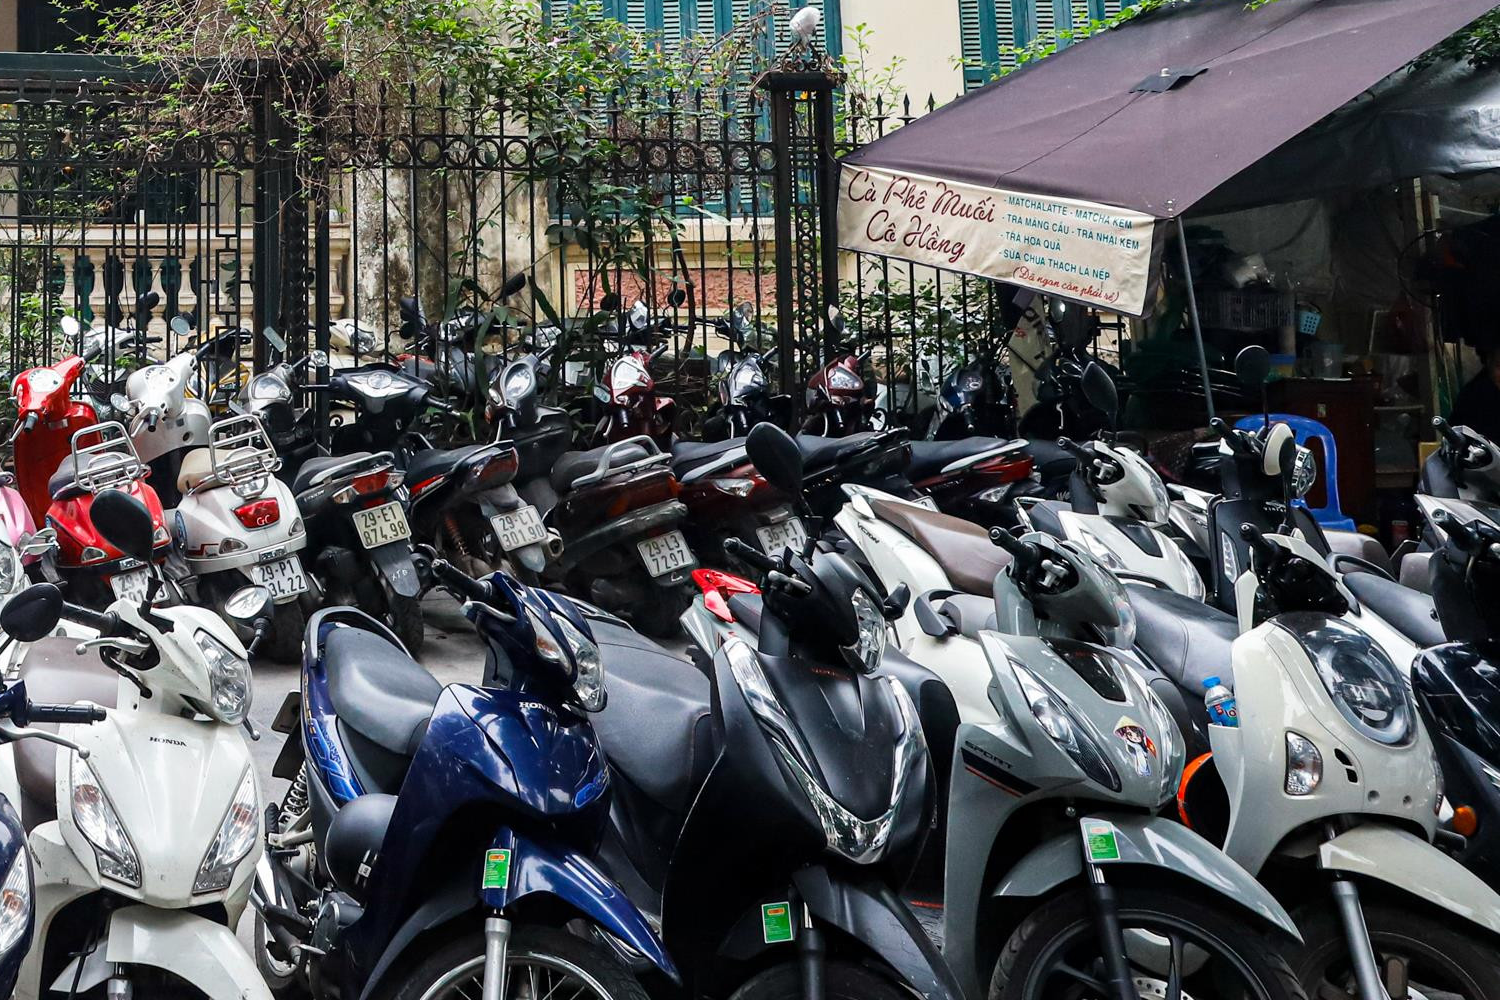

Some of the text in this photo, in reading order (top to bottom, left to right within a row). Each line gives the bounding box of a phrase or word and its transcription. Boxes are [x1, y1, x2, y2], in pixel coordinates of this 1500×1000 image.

[848, 171, 996, 223] Cà Phê Muối
[1008, 196, 1068, 216] MATCHALATTE
[1075, 209, 1110, 225] MATCHA
[866, 209, 897, 242] Cô
[1024, 236, 1042, 247] HOA
[1119, 239, 1140, 250] KEM
[361, 506, 397, 529] 29-E1
[499, 510, 534, 531] 29-C1
[363, 520, 407, 547] 874.98
[502, 524, 544, 547] 301.90
[645, 535, 680, 558] 29-L3
[261, 560, 295, 582] 29-P1
[652, 550, 686, 577] 7297
[271, 575, 305, 597] 34.22
[519, 701, 558, 718] HONDA
[149, 736, 187, 747] HONDA
